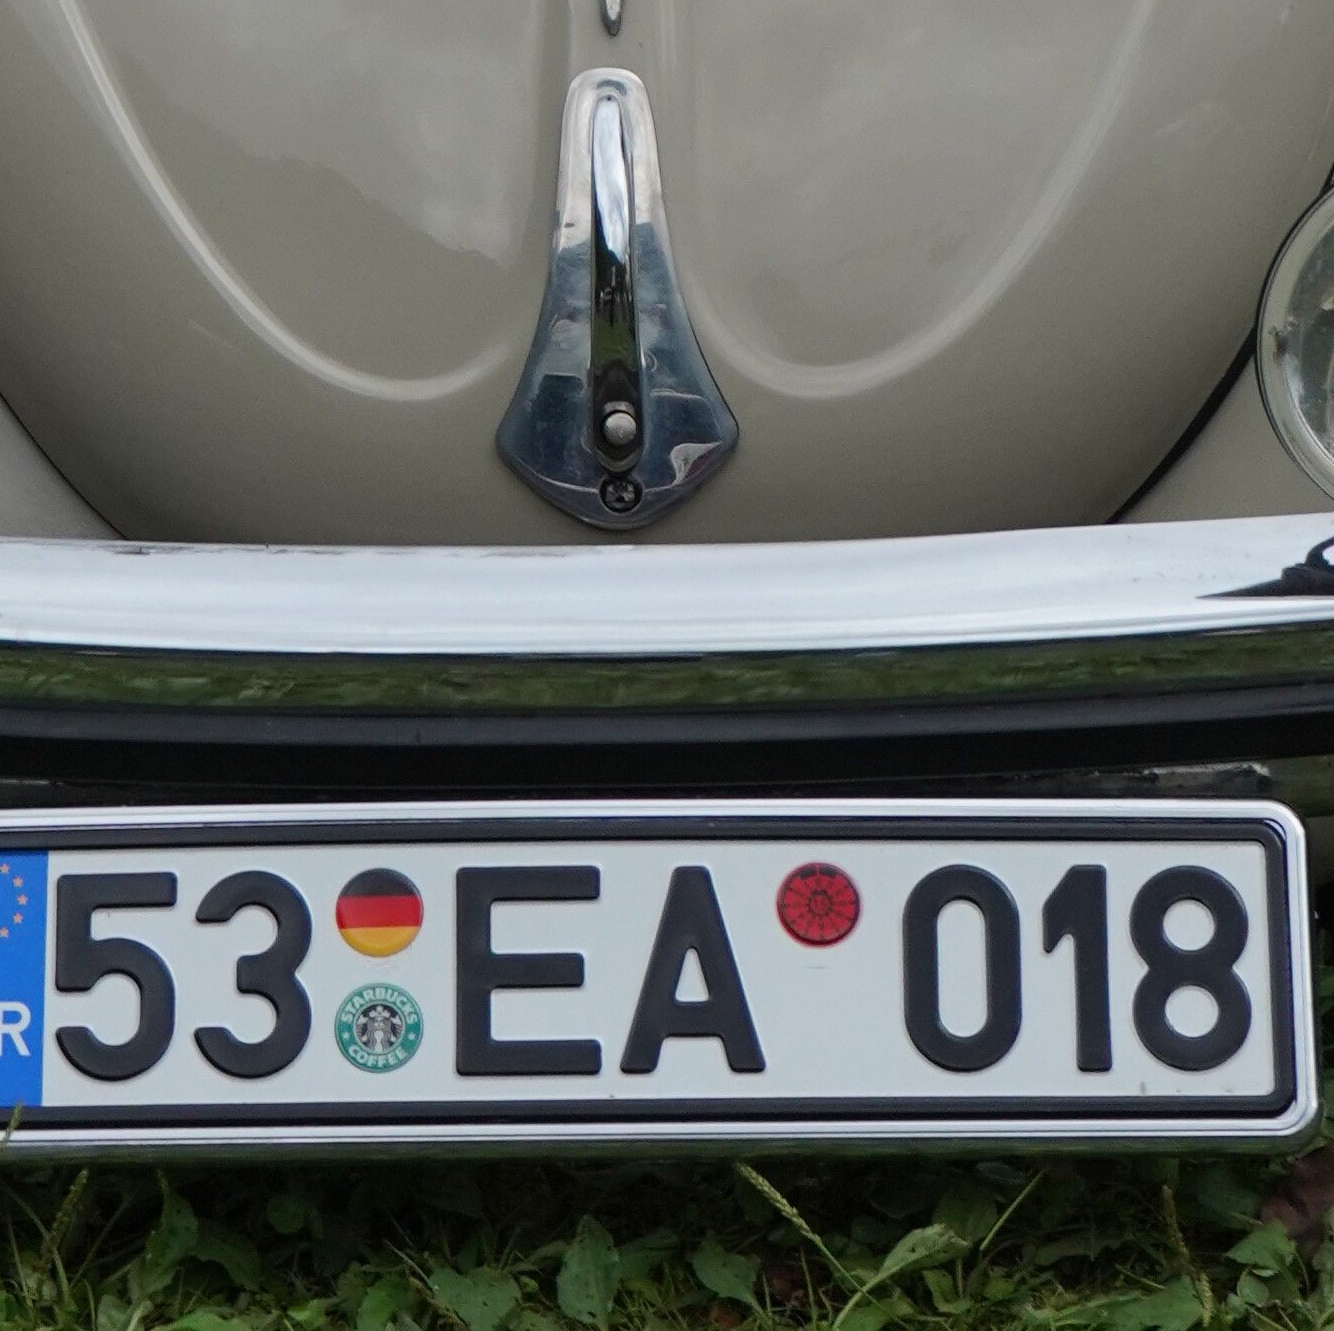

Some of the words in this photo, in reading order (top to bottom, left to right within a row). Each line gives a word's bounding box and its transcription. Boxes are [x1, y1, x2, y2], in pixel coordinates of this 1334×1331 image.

[54, 870, 312, 1083] 53
[455, 865, 766, 1077] EA
[902, 864, 1252, 1074] 018
[340, 986, 419, 1024] STARBUCKS
[348, 1044, 408, 1068] COFFEE
